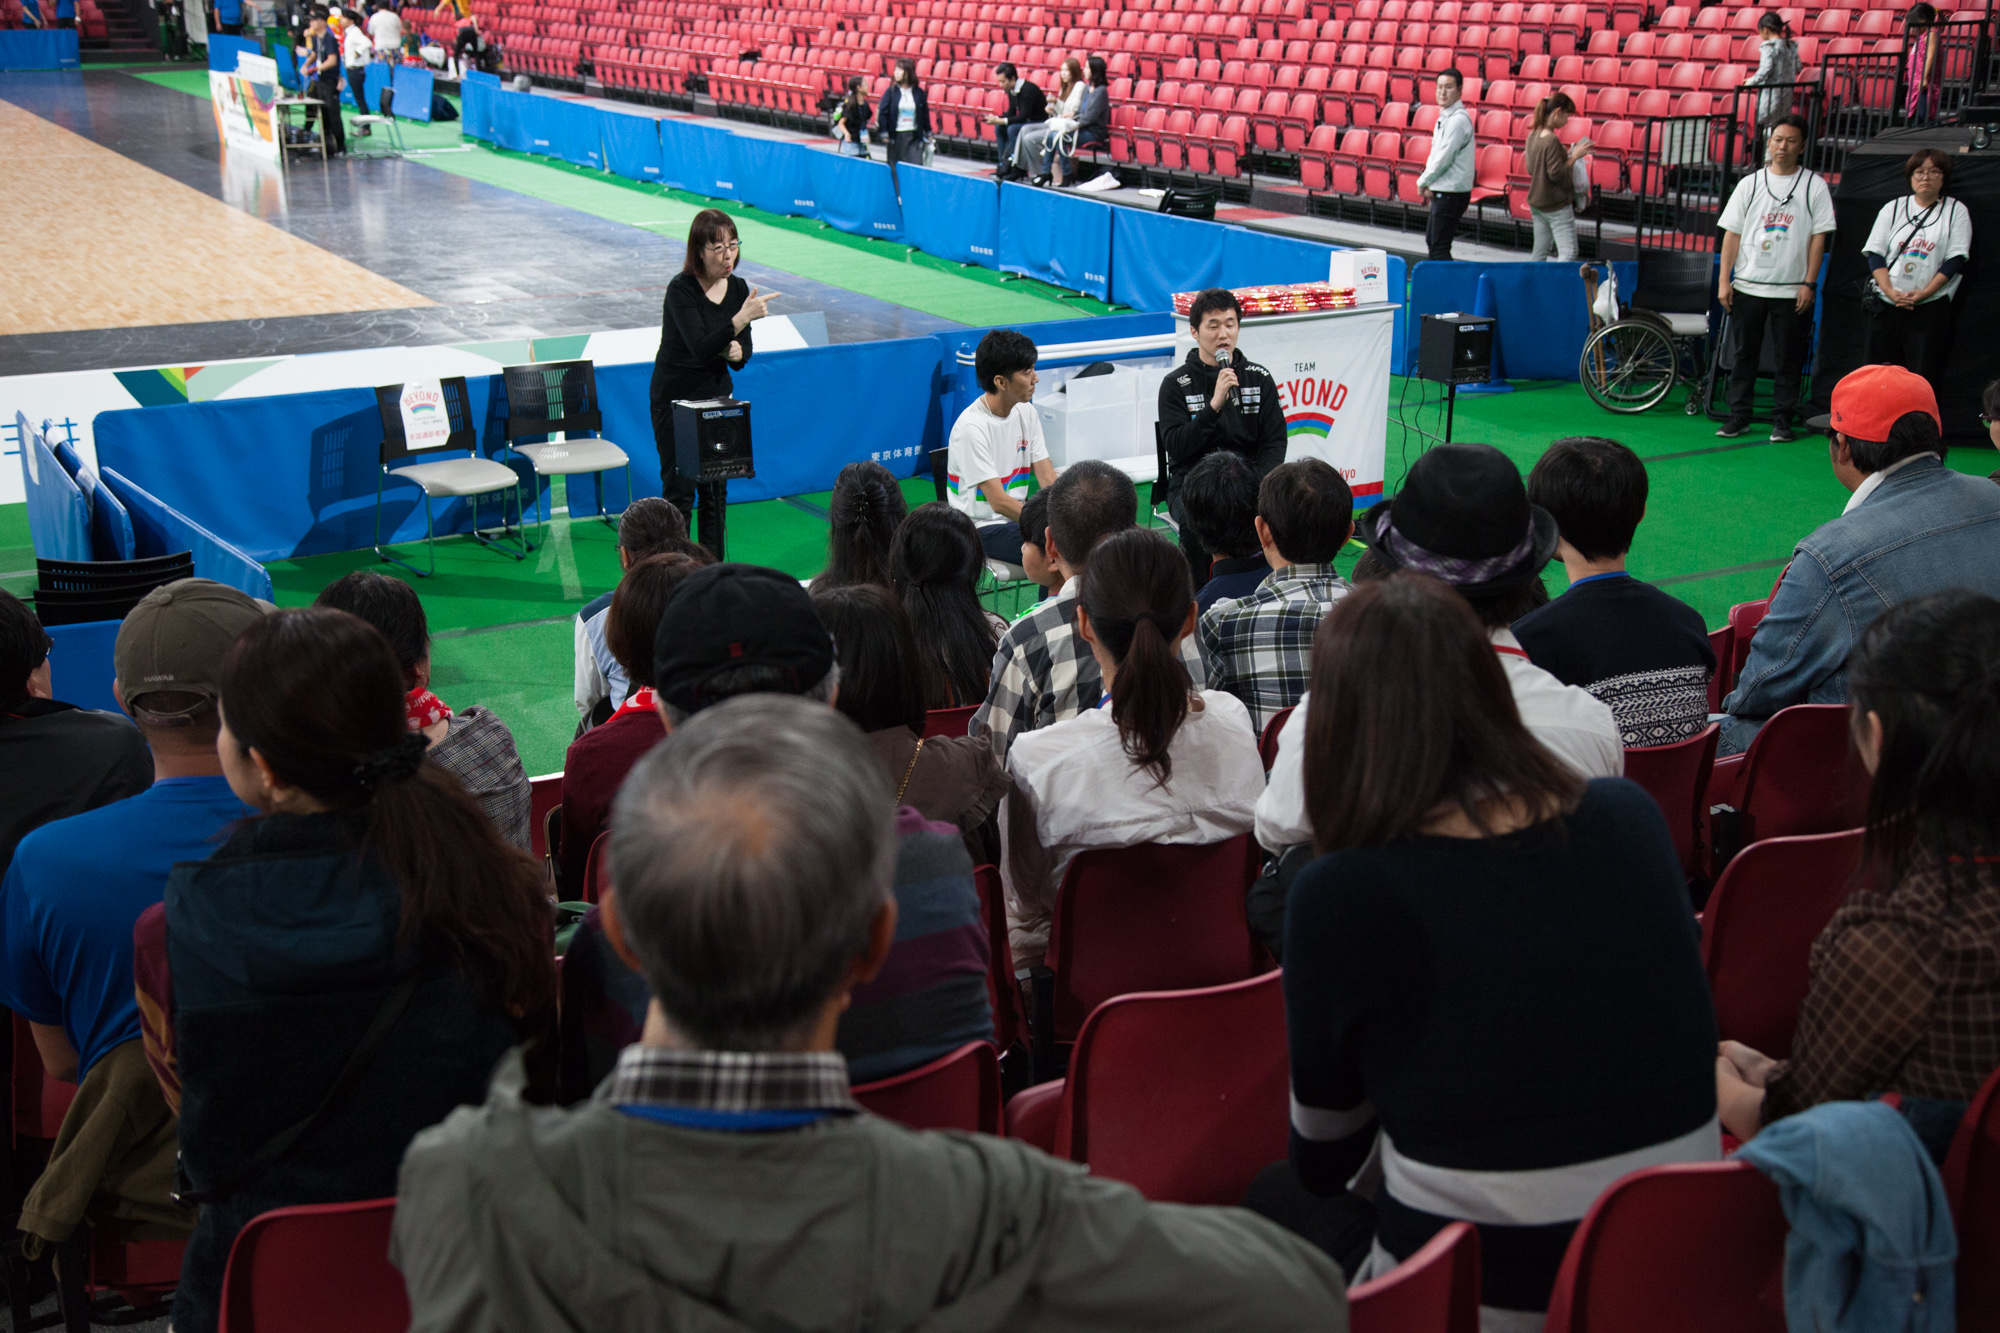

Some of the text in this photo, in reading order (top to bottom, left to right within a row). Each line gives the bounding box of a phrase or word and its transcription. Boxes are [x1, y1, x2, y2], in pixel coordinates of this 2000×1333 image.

[1245, 365, 1269, 377] JAPAN
[1294, 362, 1316, 372] TEAM
[403, 390, 439, 406] BEYOND
[1276, 377, 1349, 411] EYOND
[871, 445, 923, 461] 東京体育館
[1340, 468, 1356, 481] kyo
